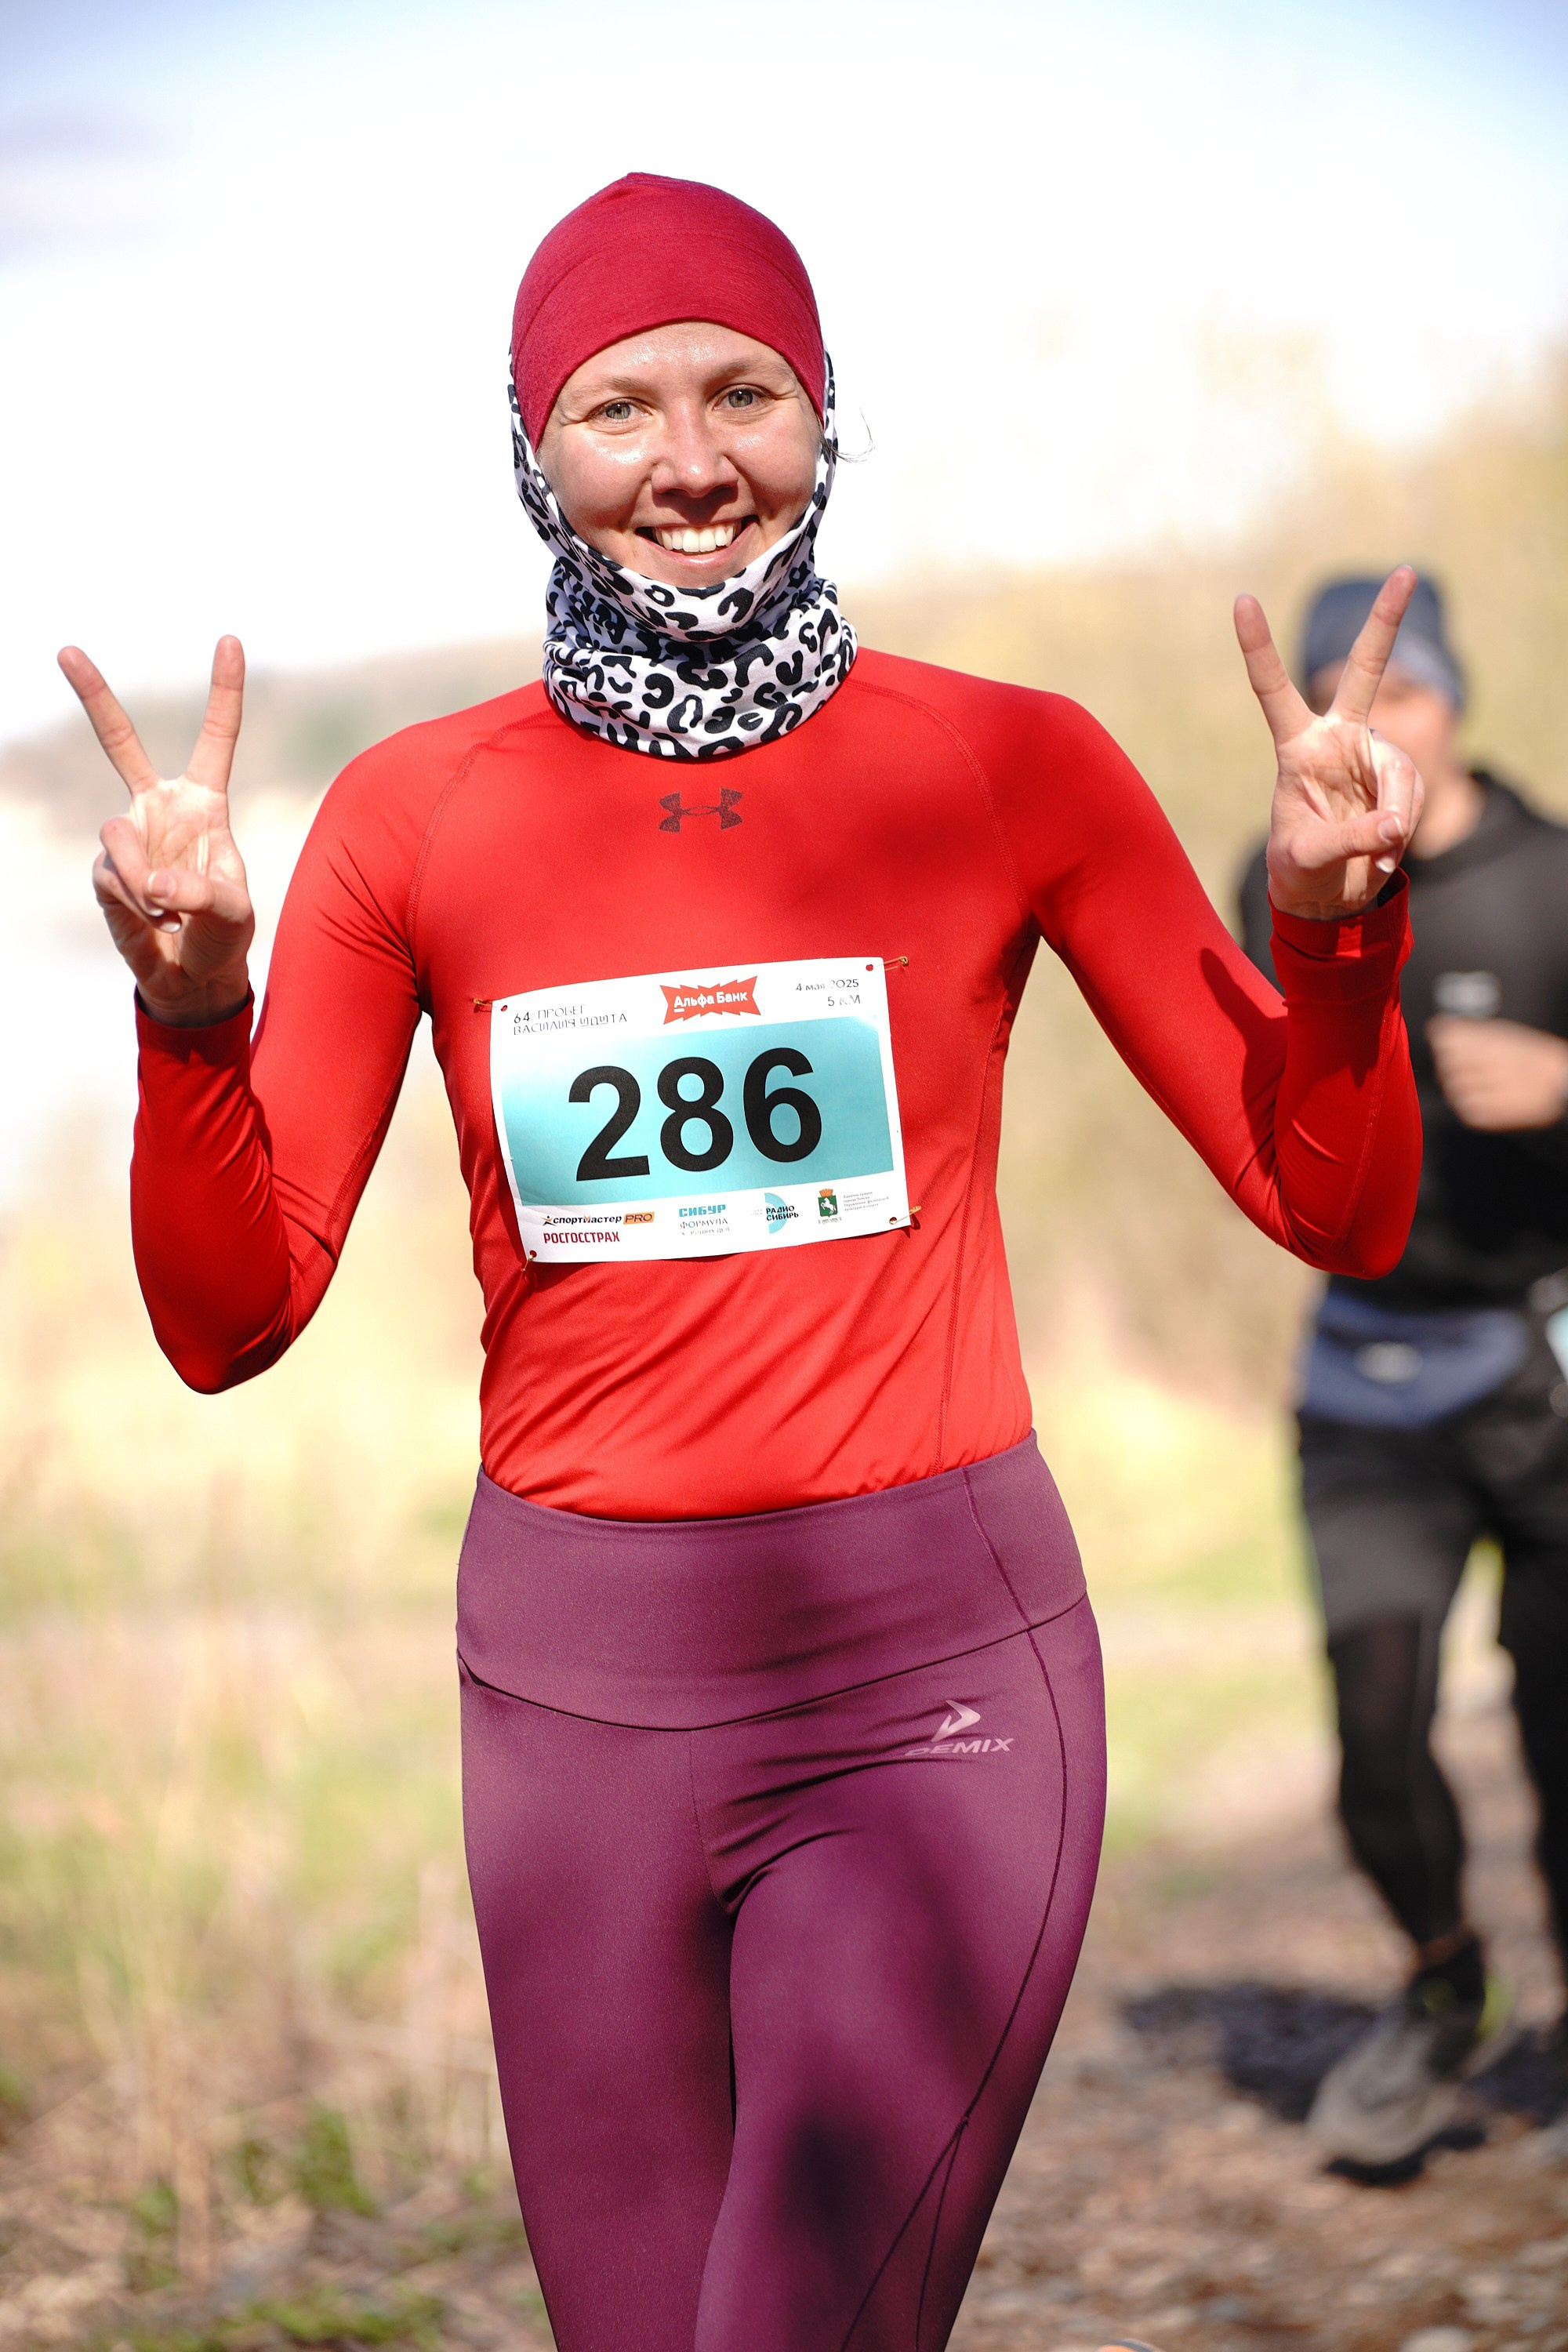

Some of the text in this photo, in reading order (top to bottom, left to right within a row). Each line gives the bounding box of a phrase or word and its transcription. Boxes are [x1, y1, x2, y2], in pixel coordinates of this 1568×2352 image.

[796, 982, 802, 991] 4
[673, 991, 749, 1009] Альфа Банк
[827, 996, 835, 1007] 5
[538, 1004, 586, 1019] ПРОБЕГ
[514, 1019, 575, 1036] ВАСИЛИЯ
[568, 1047, 822, 1182] 286
[678, 1203, 726, 1218] СИБУР
[766, 1205, 795, 1214] РАДИО
[625, 1213, 653, 1223] PRO
[766, 1211, 799, 1221] СИБИРЬ
[680, 1218, 728, 1229] ФОРМУЛА
[543, 1231, 620, 1244] РОСГОССТРАХ
